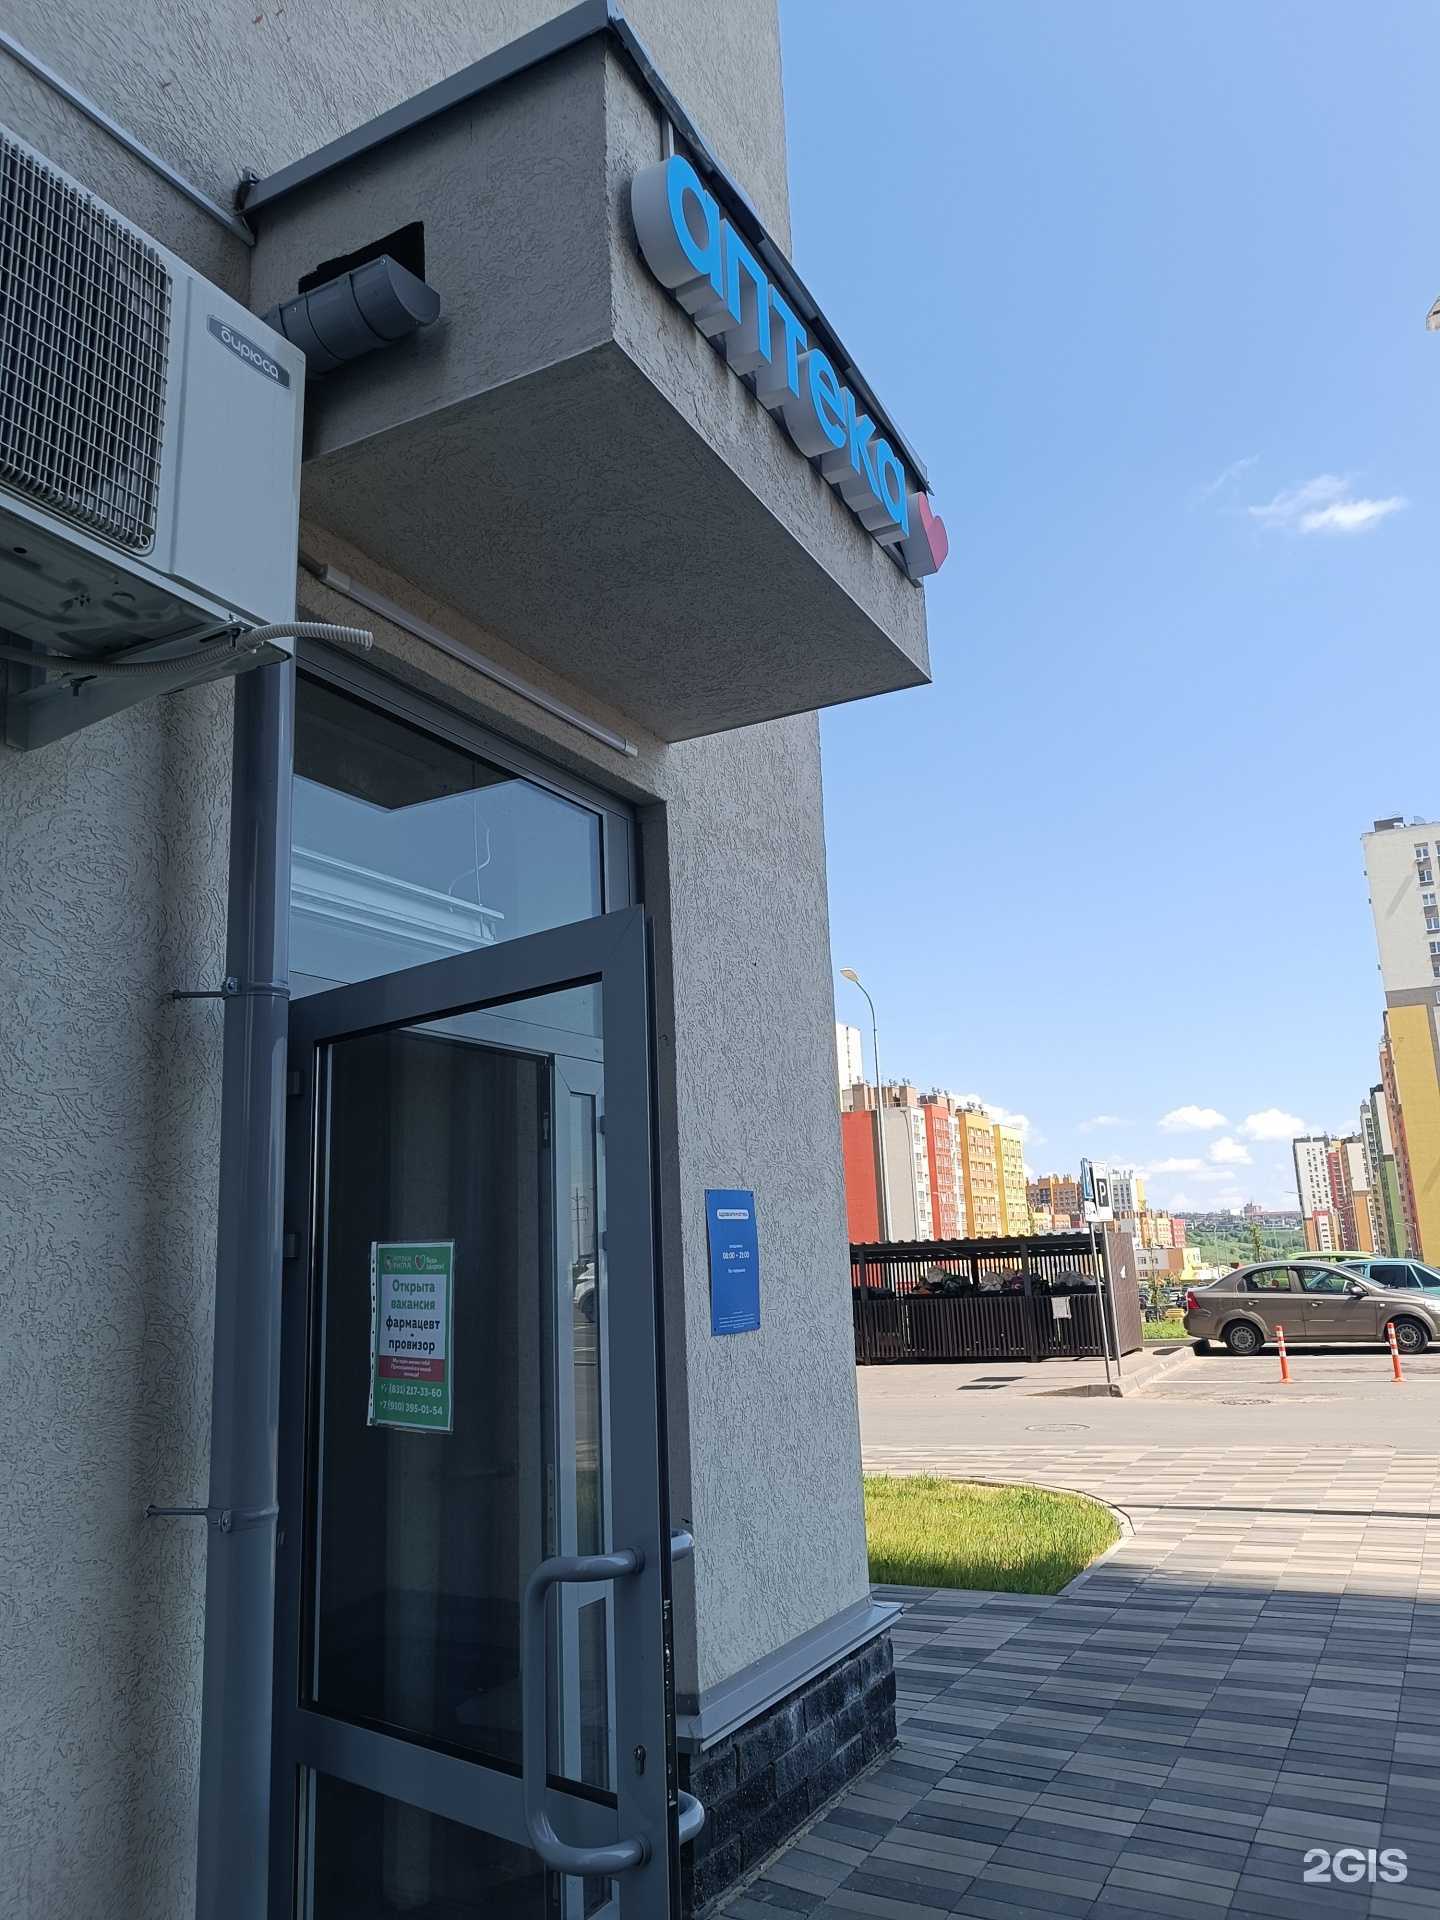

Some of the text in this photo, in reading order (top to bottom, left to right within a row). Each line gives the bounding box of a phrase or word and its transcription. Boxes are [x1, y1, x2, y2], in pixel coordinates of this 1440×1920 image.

[655, 154, 910, 538] аптека
[1099, 1182, 1106, 1204] P
[392, 1279, 436, 1295] Открыта
[391, 1299, 436, 1310] вакансия
[385, 1315, 441, 1331] фармацевт
[388, 1339, 436, 1354] провизор
[406, 1385, 442, 1398] 217-33-60
